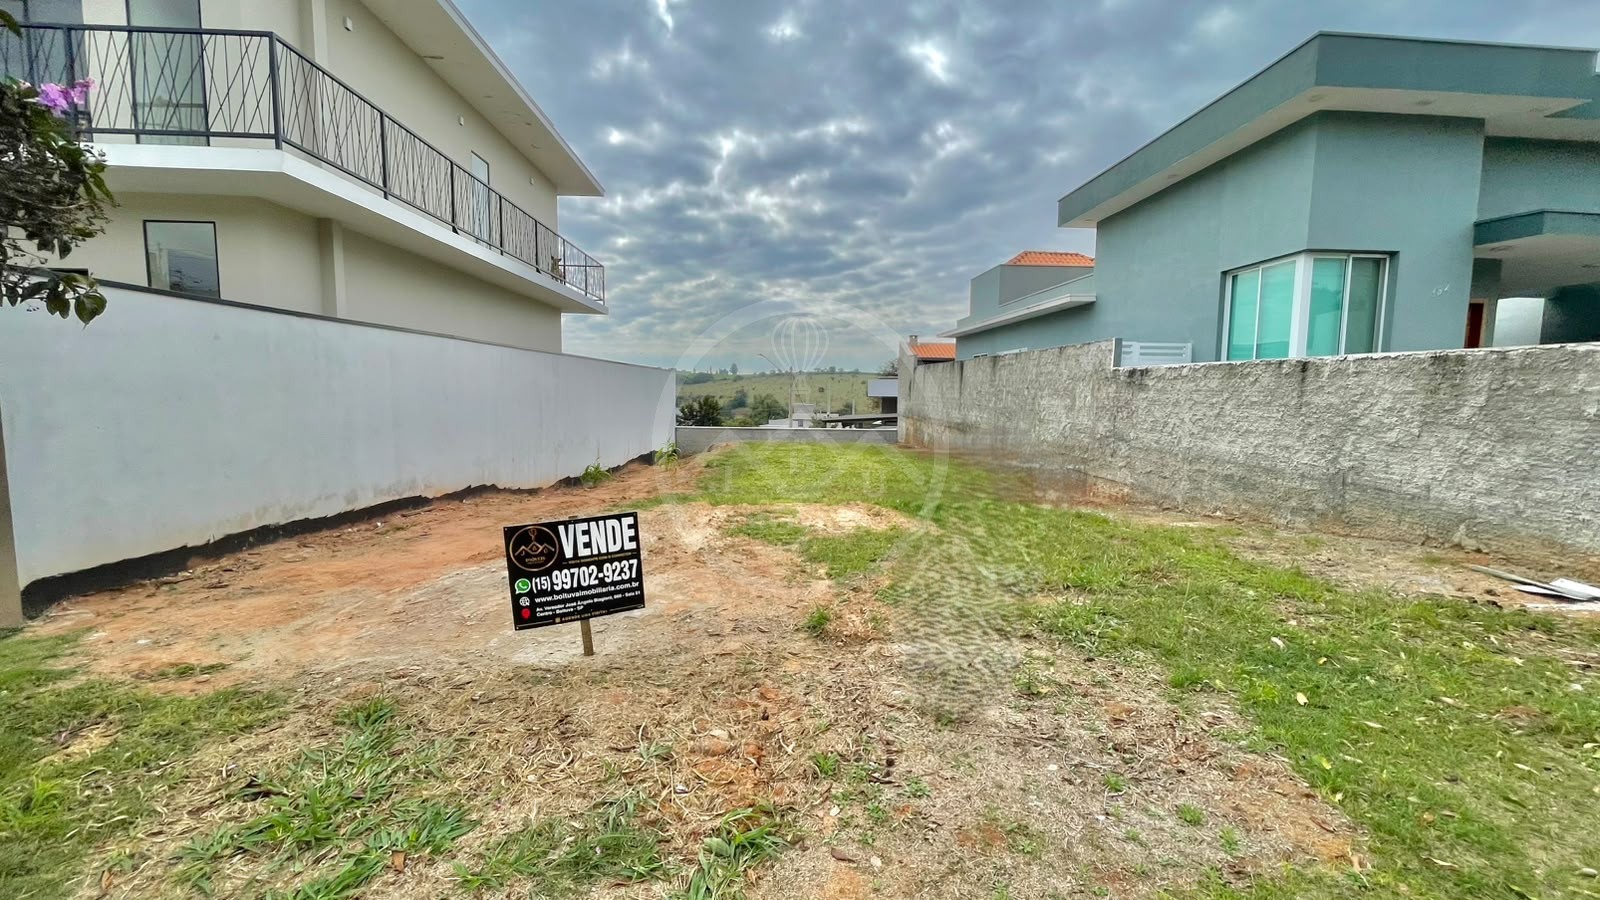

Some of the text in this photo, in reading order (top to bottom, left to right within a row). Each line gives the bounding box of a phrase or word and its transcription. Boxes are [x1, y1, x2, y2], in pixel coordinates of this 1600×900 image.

[557, 517, 637, 559] VENDE
[532, 559, 638, 594] (15) 99702-9237
[534, 581, 640, 603] www.boituvaimobiliaria.com.br
